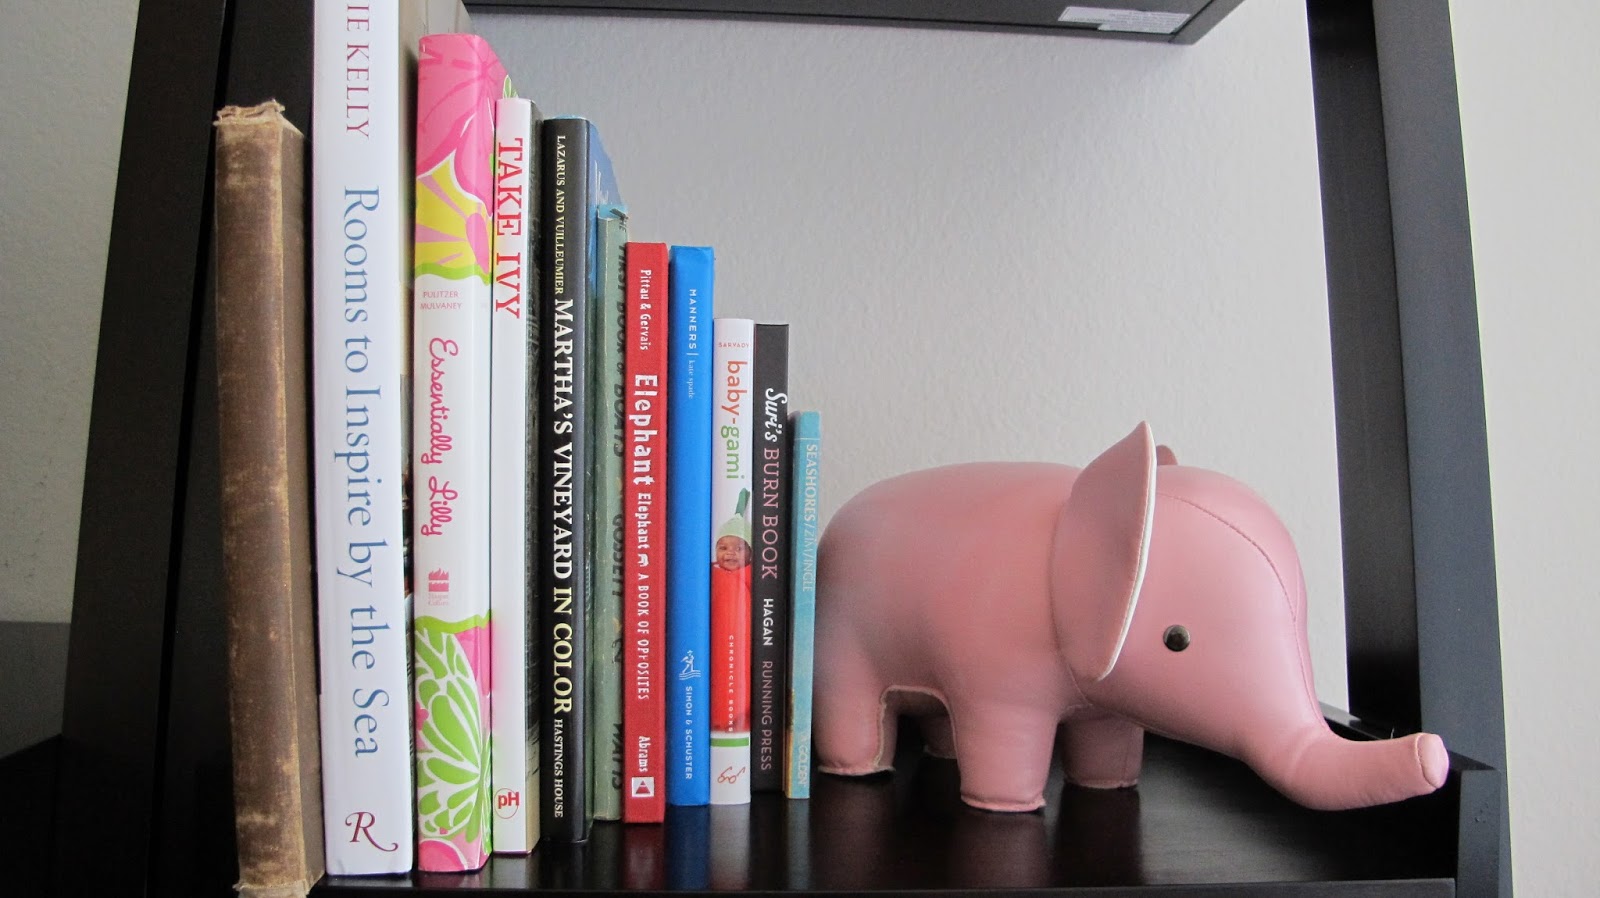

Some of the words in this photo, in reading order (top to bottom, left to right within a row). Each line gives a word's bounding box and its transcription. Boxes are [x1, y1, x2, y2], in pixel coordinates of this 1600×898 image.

[346, 41, 370, 140] KELLY
[496, 137, 523, 236] TAKE
[556, 135, 566, 186] LAZARUS
[555, 188, 565, 213] AND
[344, 186, 380, 324] Rooms
[554, 216, 565, 295] VUILLEUMIER
[420, 302, 462, 310] MULVANEY
[423, 290, 459, 298] PULITZER
[495, 252, 521, 319] IVY
[640, 269, 652, 300] Pittau
[640, 314, 651, 350] Gervais
[688, 289, 697, 349] MANNERS
[345, 336, 372, 374] to
[553, 299, 574, 435] MARTHA'S
[687, 360, 695, 376] kate
[421, 337, 458, 464] Essentially
[686, 378, 694, 399] spade
[628, 374, 658, 486] Elephant
[721, 360, 748, 480] baby-gami
[764, 388, 787, 443] Suri's
[335, 386, 382, 527] Inspire
[763, 448, 780, 508] BURN
[421, 475, 458, 536] Lilly
[553, 442, 574, 578] VINEYARD
[637, 492, 652, 549] Elephant
[337, 538, 388, 588] by
[762, 515, 778, 579] BOOK
[553, 587, 573, 614] IN
[637, 573, 649, 581] A
[637, 585, 649, 616] BOOK
[350, 604, 390, 669] the
[637, 620, 649, 635] OF
[763, 598, 774, 647] HAGAN
[553, 622, 573, 713] COLOR
[761, 661, 773, 725] RUNNING
[353, 688, 390, 758] Sea
[685, 686, 693, 716] SIMON
[554, 718, 564, 778] HASTINGS
[638, 735, 650, 772] Abrams
[684, 729, 693, 779] SCHUSTER
[761, 730, 772, 771] PRESS
[497, 791, 520, 809] pH
[554, 782, 564, 818] HOUSE
[345, 811, 399, 852] R
